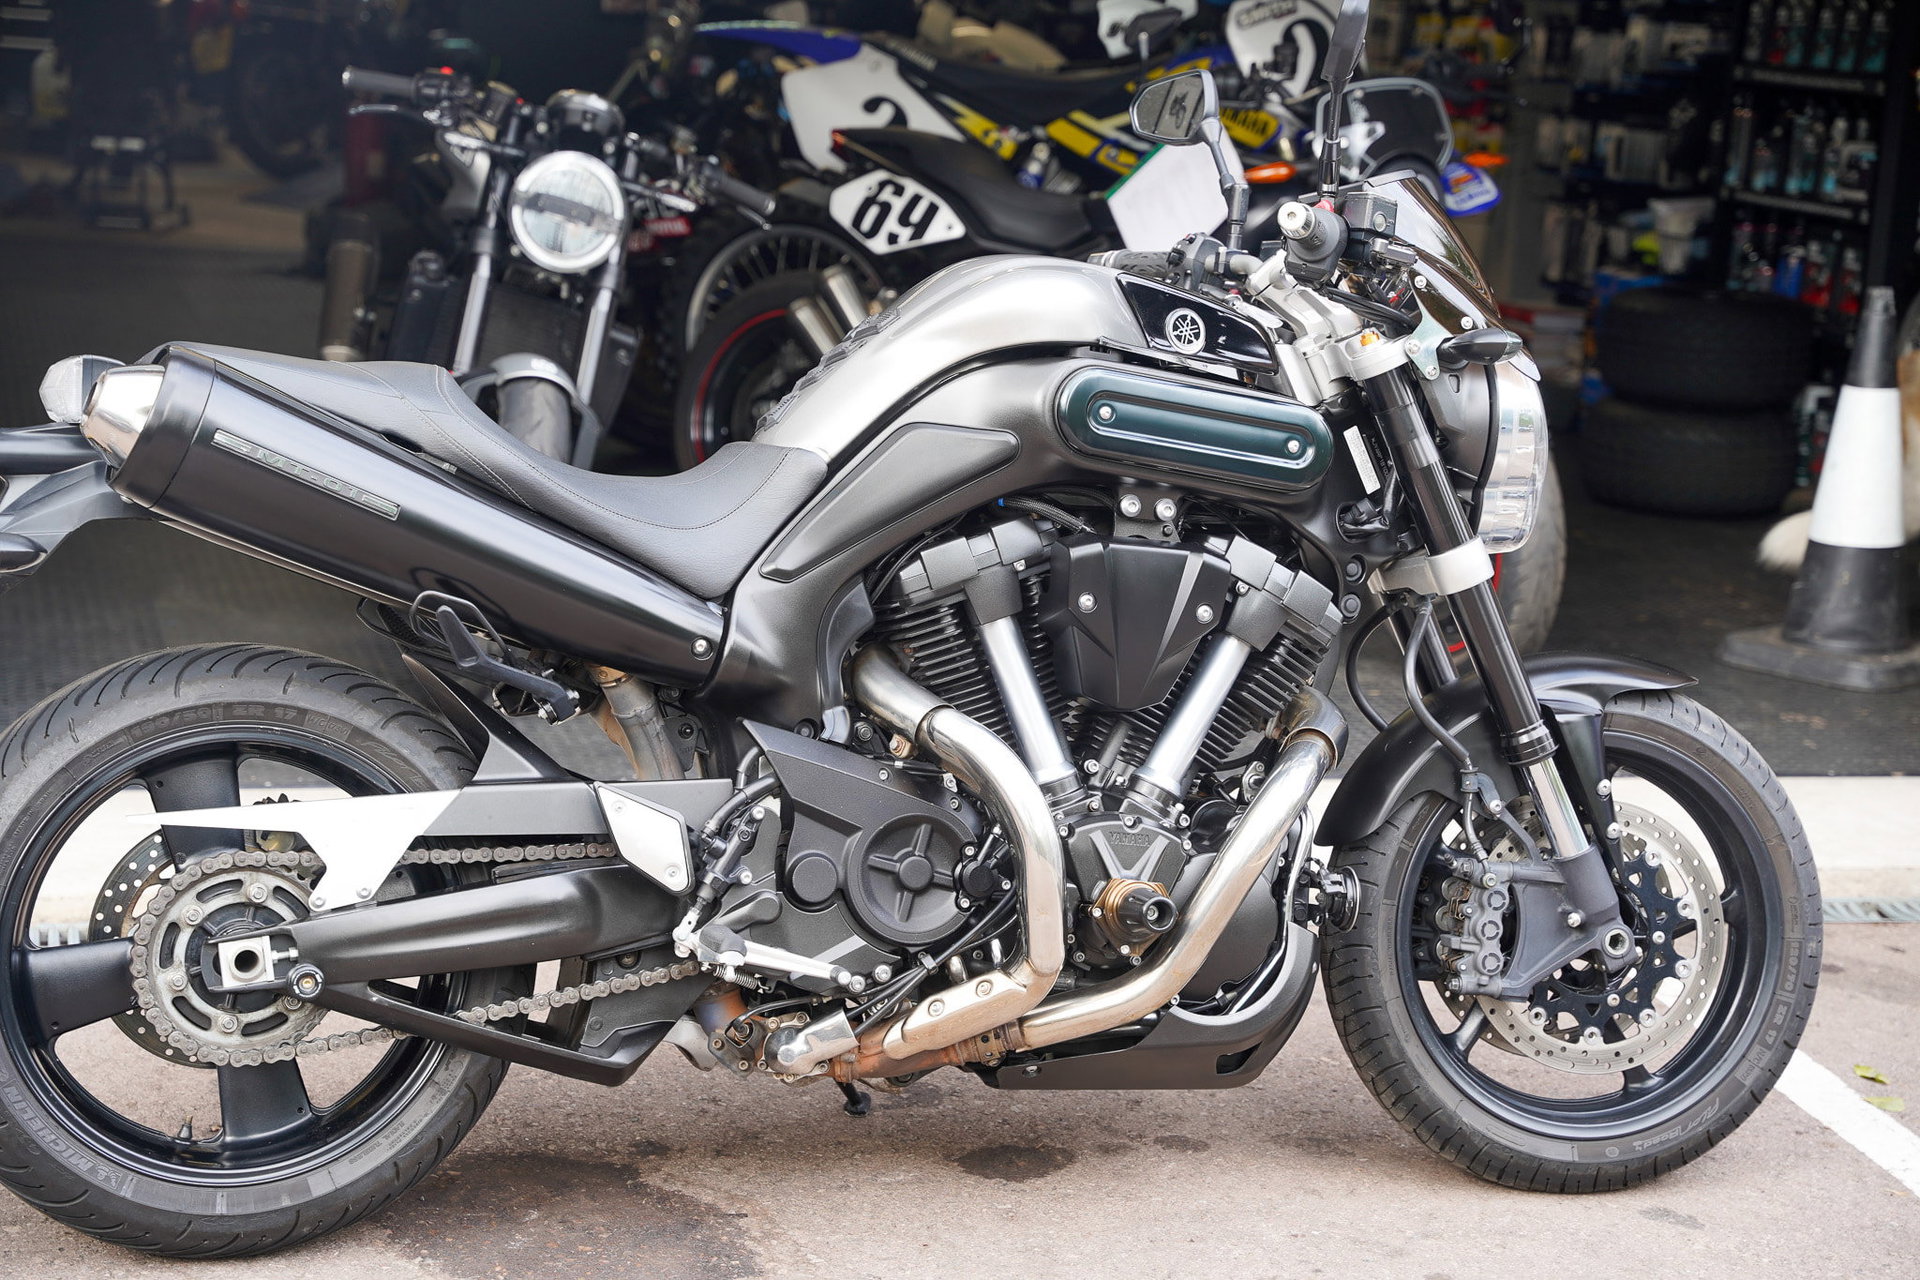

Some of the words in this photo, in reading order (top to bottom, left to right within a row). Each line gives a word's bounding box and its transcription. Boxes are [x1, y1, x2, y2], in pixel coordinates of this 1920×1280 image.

[257, 450, 358, 499] MT-01
[1110, 831, 1150, 847] YAMAHA
[4, 1086, 94, 1172] MICHELIN
